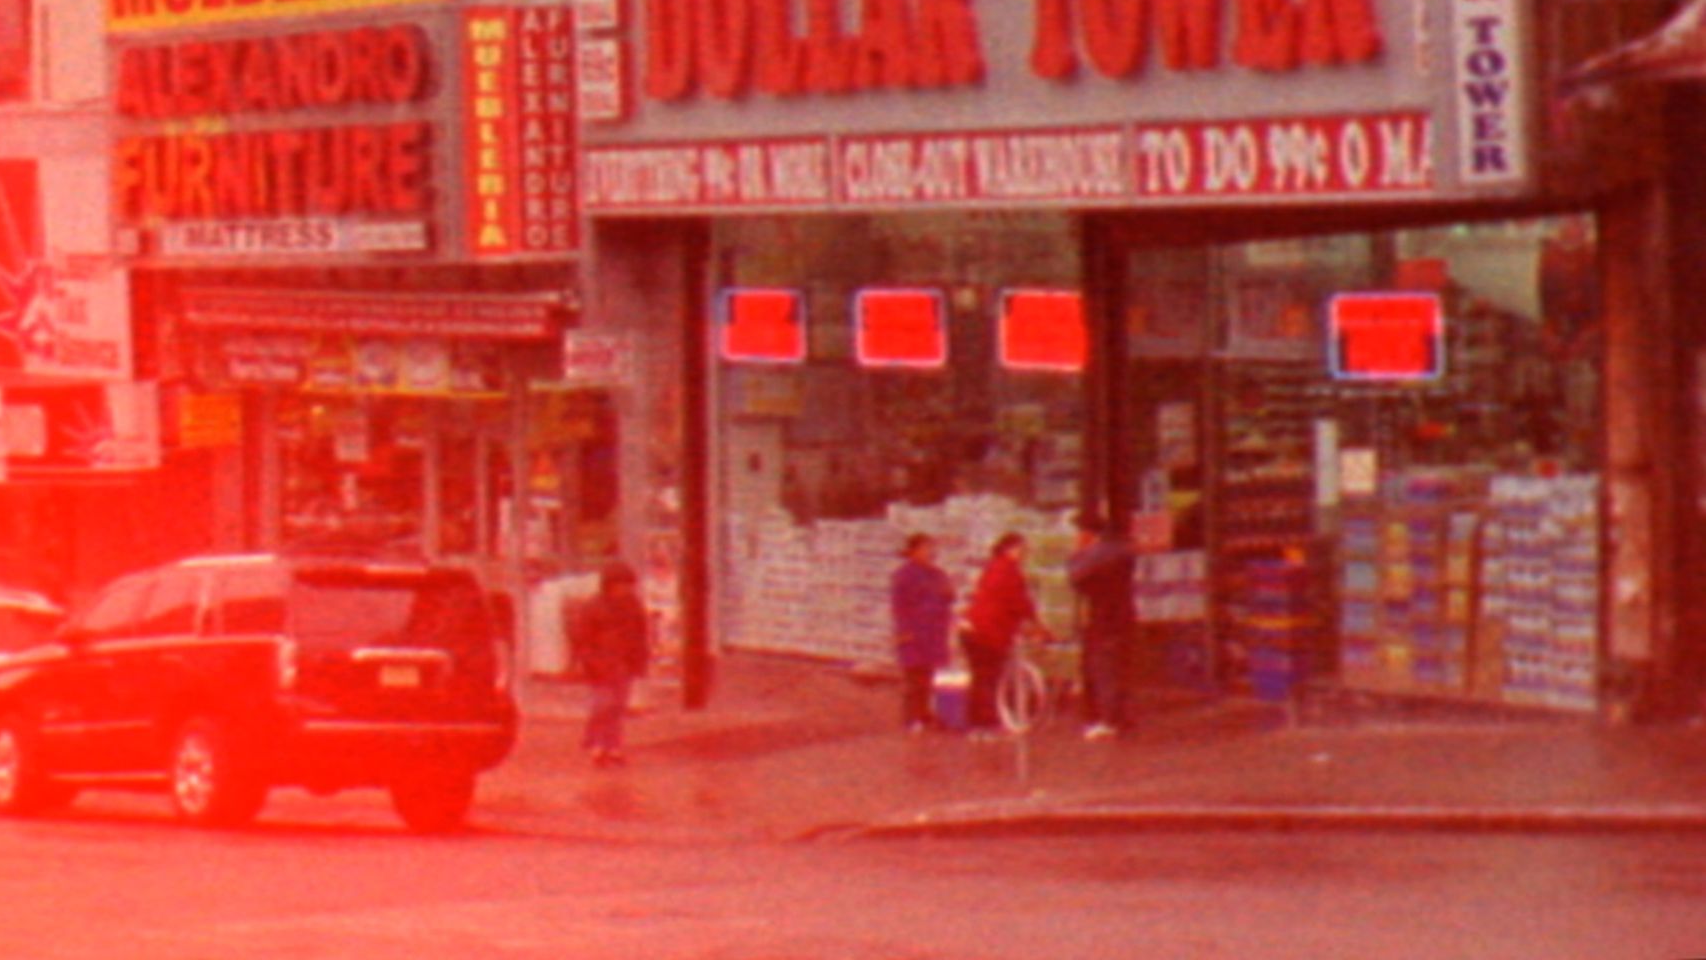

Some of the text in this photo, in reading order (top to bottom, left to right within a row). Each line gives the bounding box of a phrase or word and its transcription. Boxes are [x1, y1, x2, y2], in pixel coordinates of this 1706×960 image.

[115, 23, 434, 120] ALEXANDRO
[469, 18, 507, 247] MUEBLERIA
[522, 9, 549, 247] ALEXANDRO
[548, 8, 571, 247] FURNITURE
[1464, 16, 1506, 172] TOWER
[112, 120, 430, 221] FURNITURE
[1140, 127, 1191, 191] TO
[1201, 124, 1259, 190] DO
[1341, 119, 1370, 187] O
